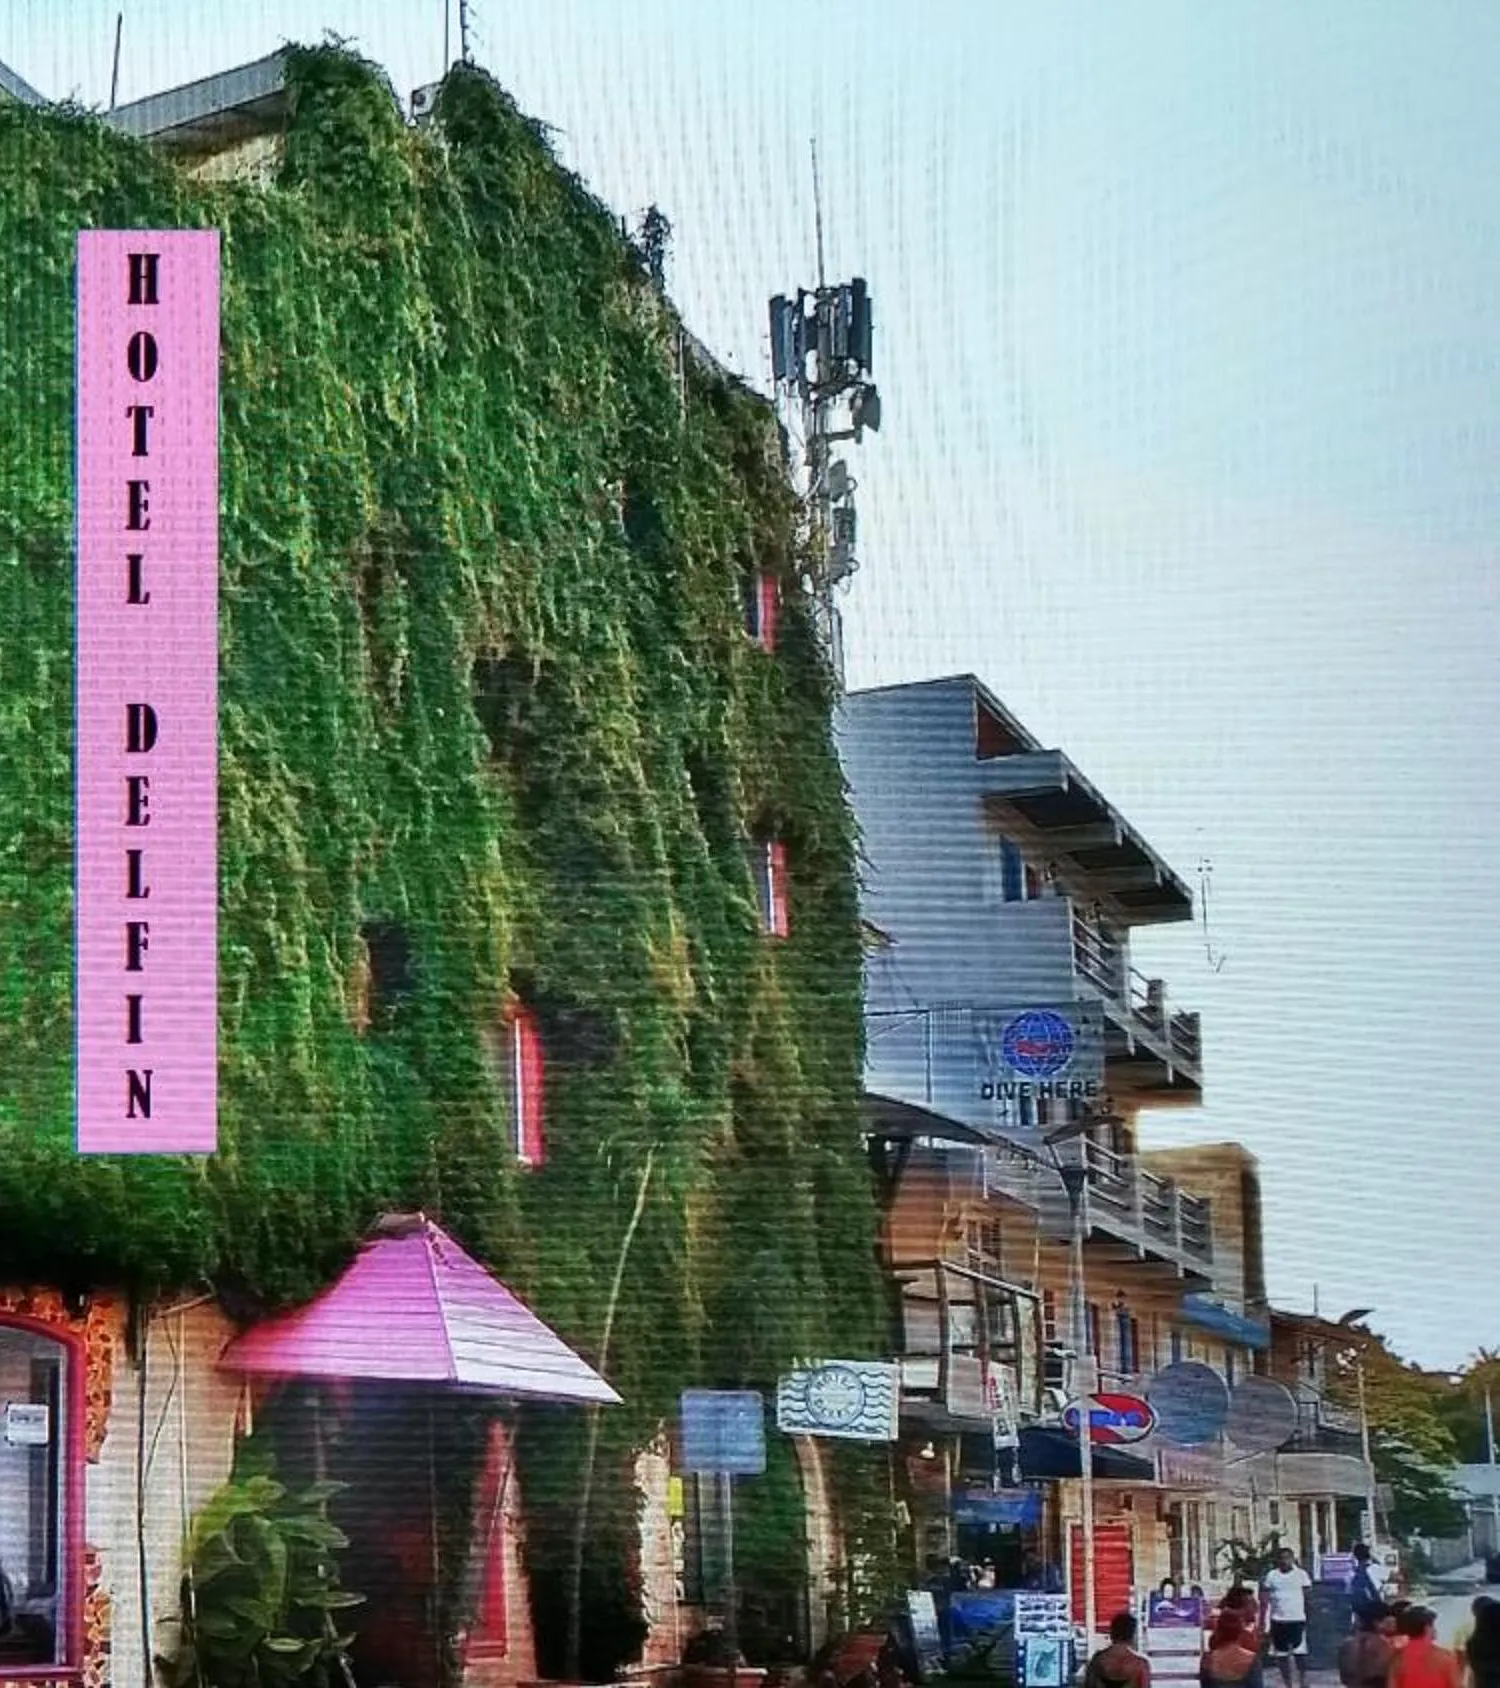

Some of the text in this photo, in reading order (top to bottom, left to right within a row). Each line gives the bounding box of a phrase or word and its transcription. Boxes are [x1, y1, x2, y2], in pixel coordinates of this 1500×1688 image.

[124, 253, 161, 1119] HOTEL DELFIN
[980, 1081, 1097, 1100] DIVE HERE
